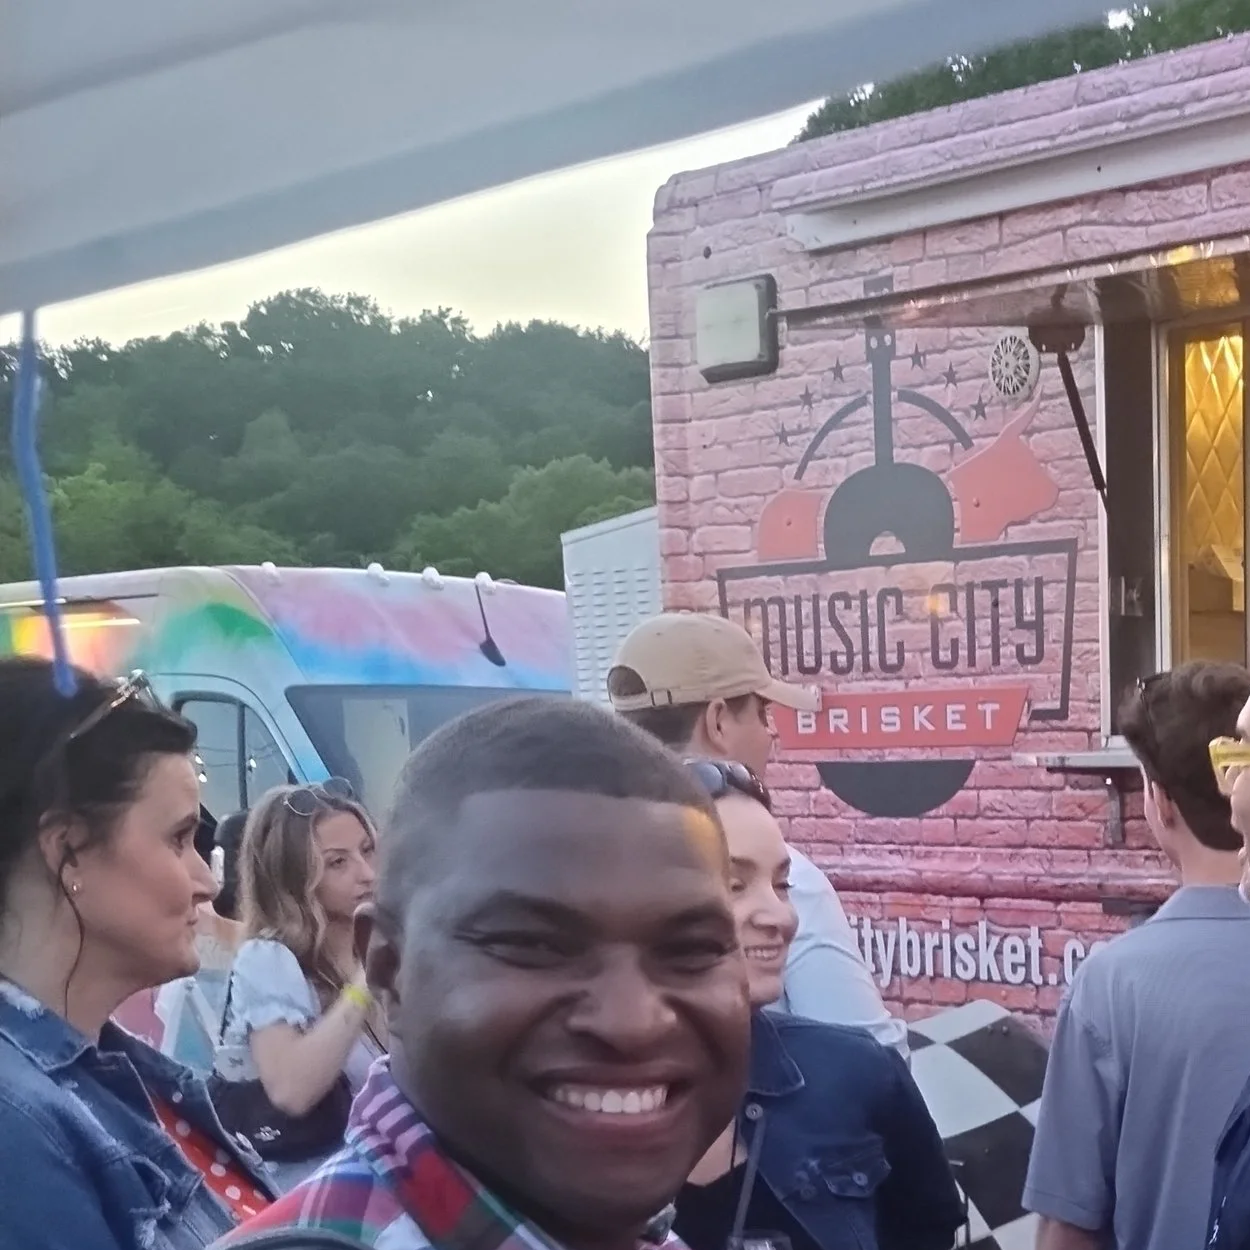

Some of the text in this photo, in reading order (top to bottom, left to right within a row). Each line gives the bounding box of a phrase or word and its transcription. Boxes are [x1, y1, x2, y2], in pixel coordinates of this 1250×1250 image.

[744, 576, 1045, 676] MUSIC CITY
[797, 703, 1000, 734] BRISKET
